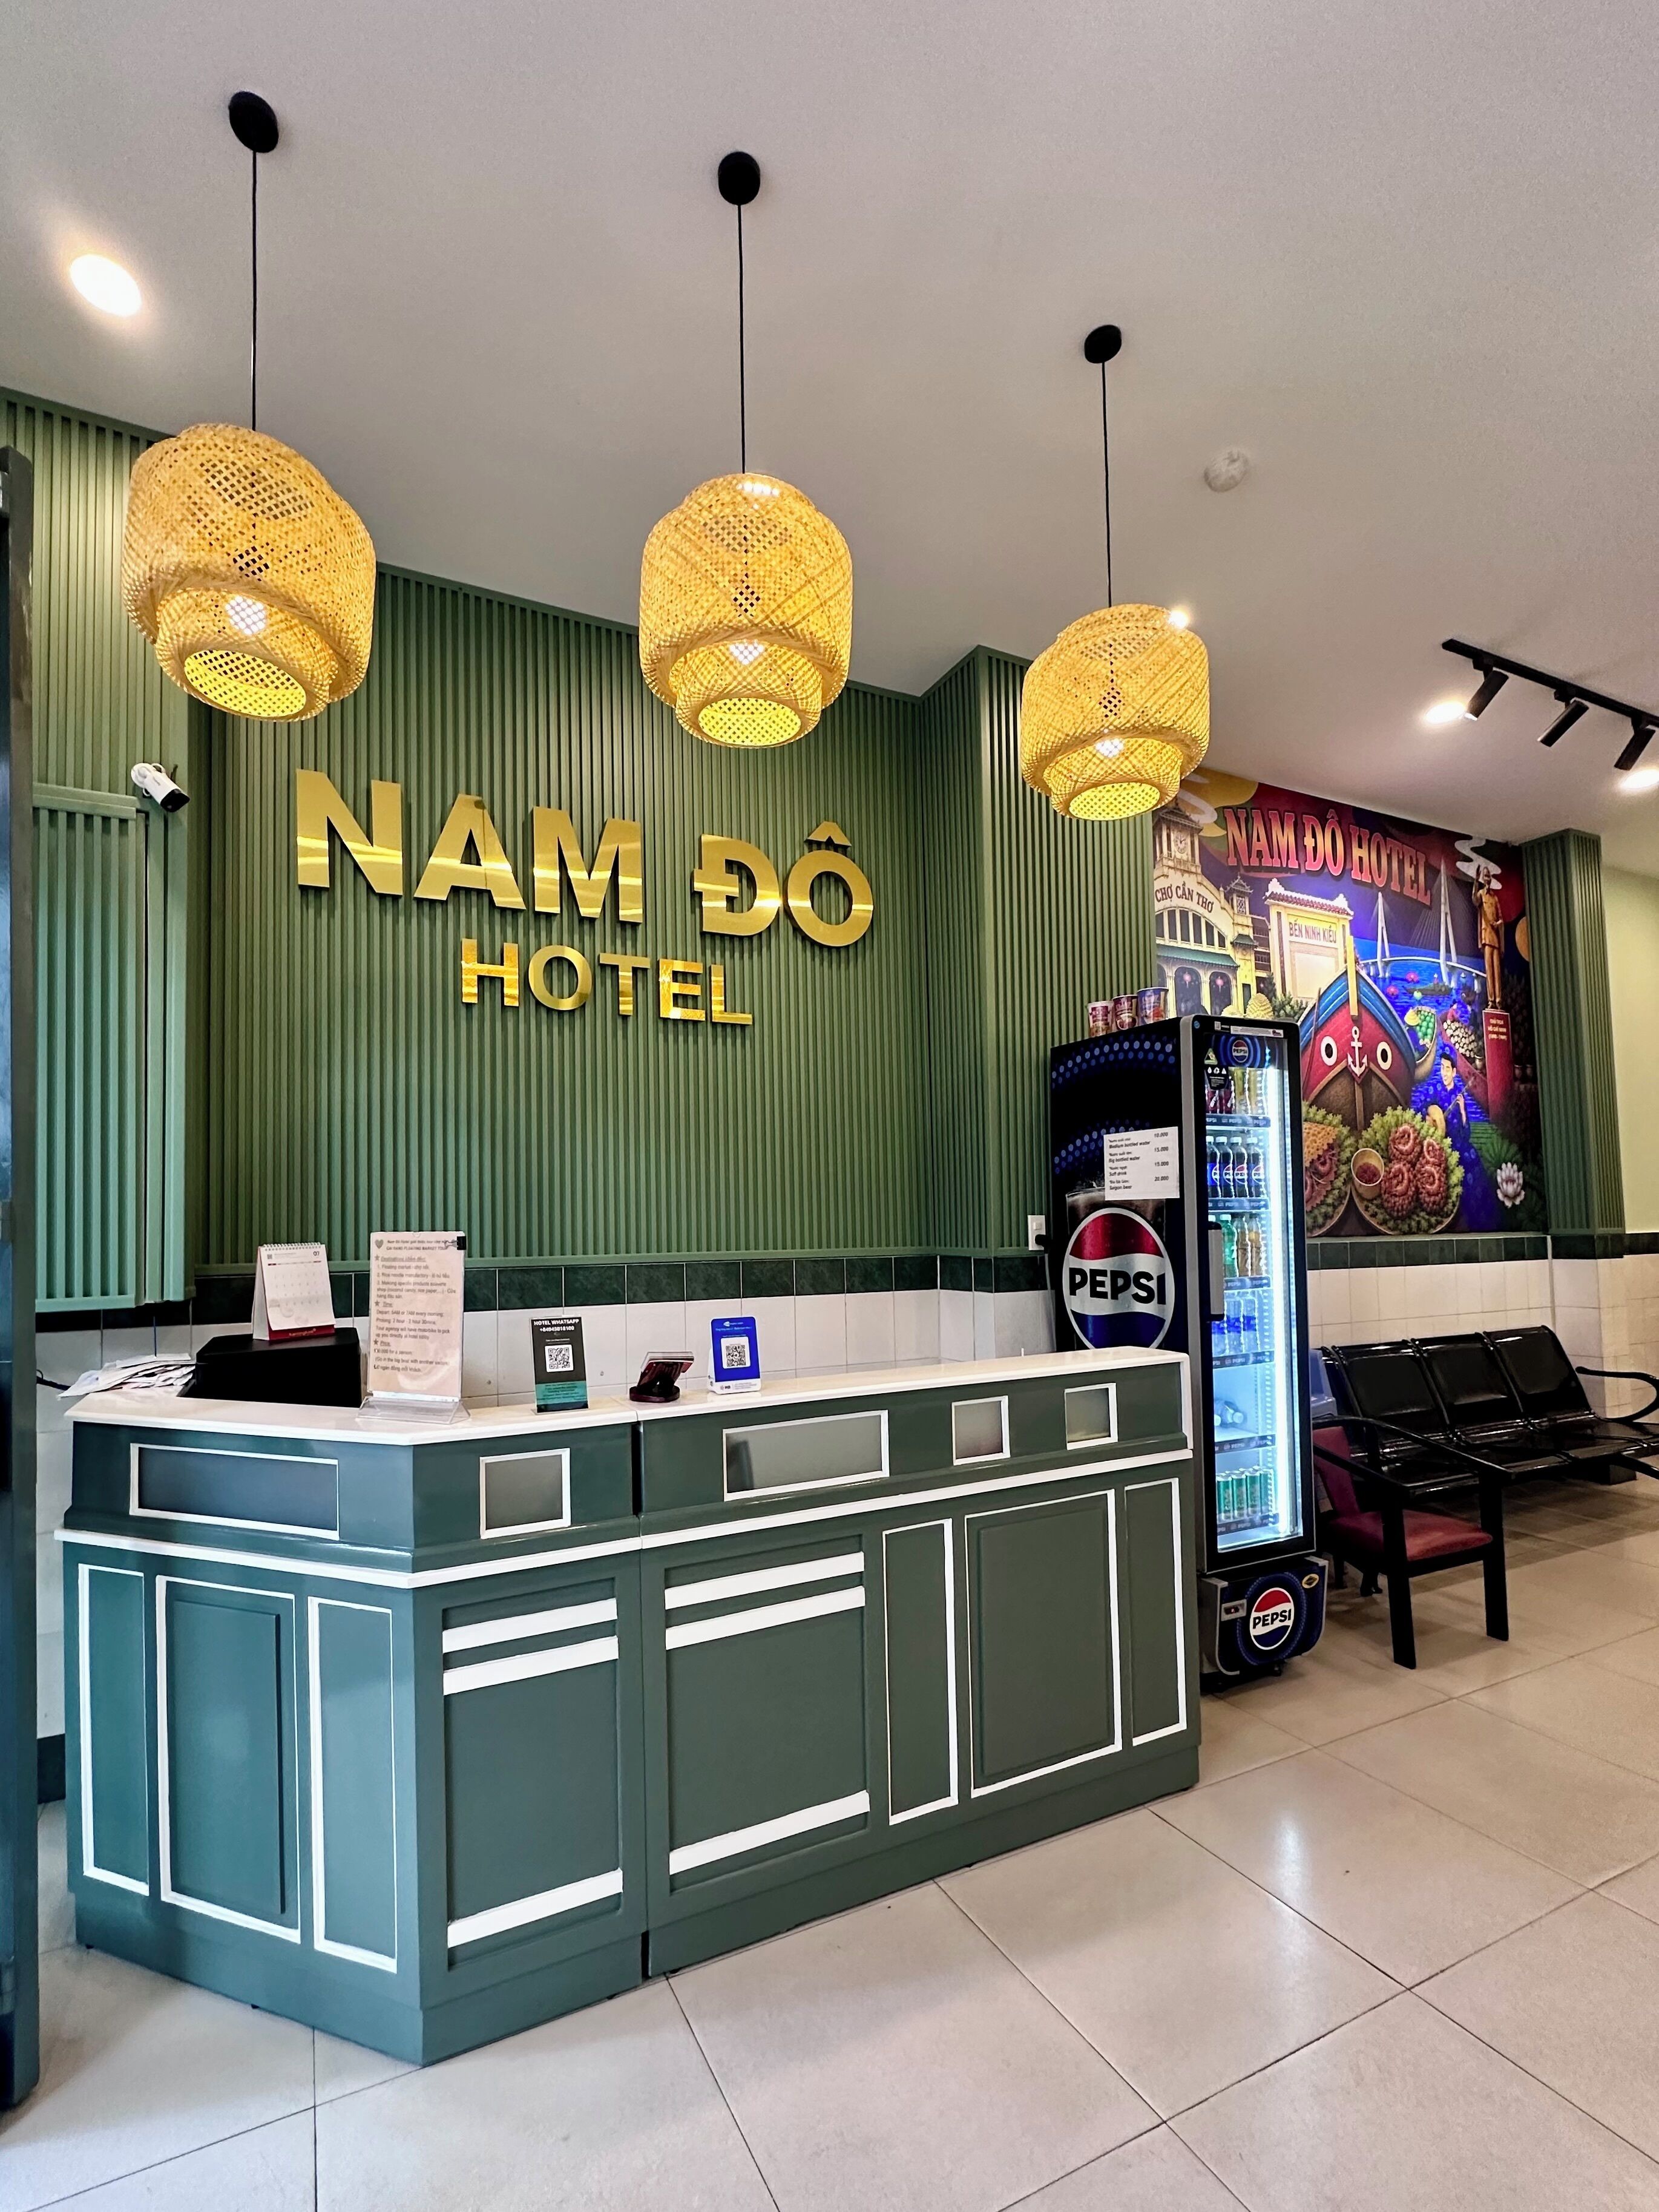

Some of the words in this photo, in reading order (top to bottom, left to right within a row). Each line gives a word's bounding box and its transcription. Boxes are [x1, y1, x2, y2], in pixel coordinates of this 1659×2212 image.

[296, 769, 644, 924] NAM
[694, 820, 874, 948] ĐÔ
[1224, 809, 1299, 868] NAM
[1303, 809, 1344, 876] ĐÔ
[1350, 824, 1431, 906] HOTEL
[1155, 884, 1174, 903] CHỢ
[1175, 881, 1194, 902] CẦN
[1196, 891, 1215, 914] THƠ
[1289, 917, 1303, 938] BẾN
[1304, 924, 1321, 942] NINH
[461, 937, 754, 1026] HOTEL
[1069, 1267, 1166, 1305] PEPSI
[1252, 1609, 1292, 1629] PEPSI
